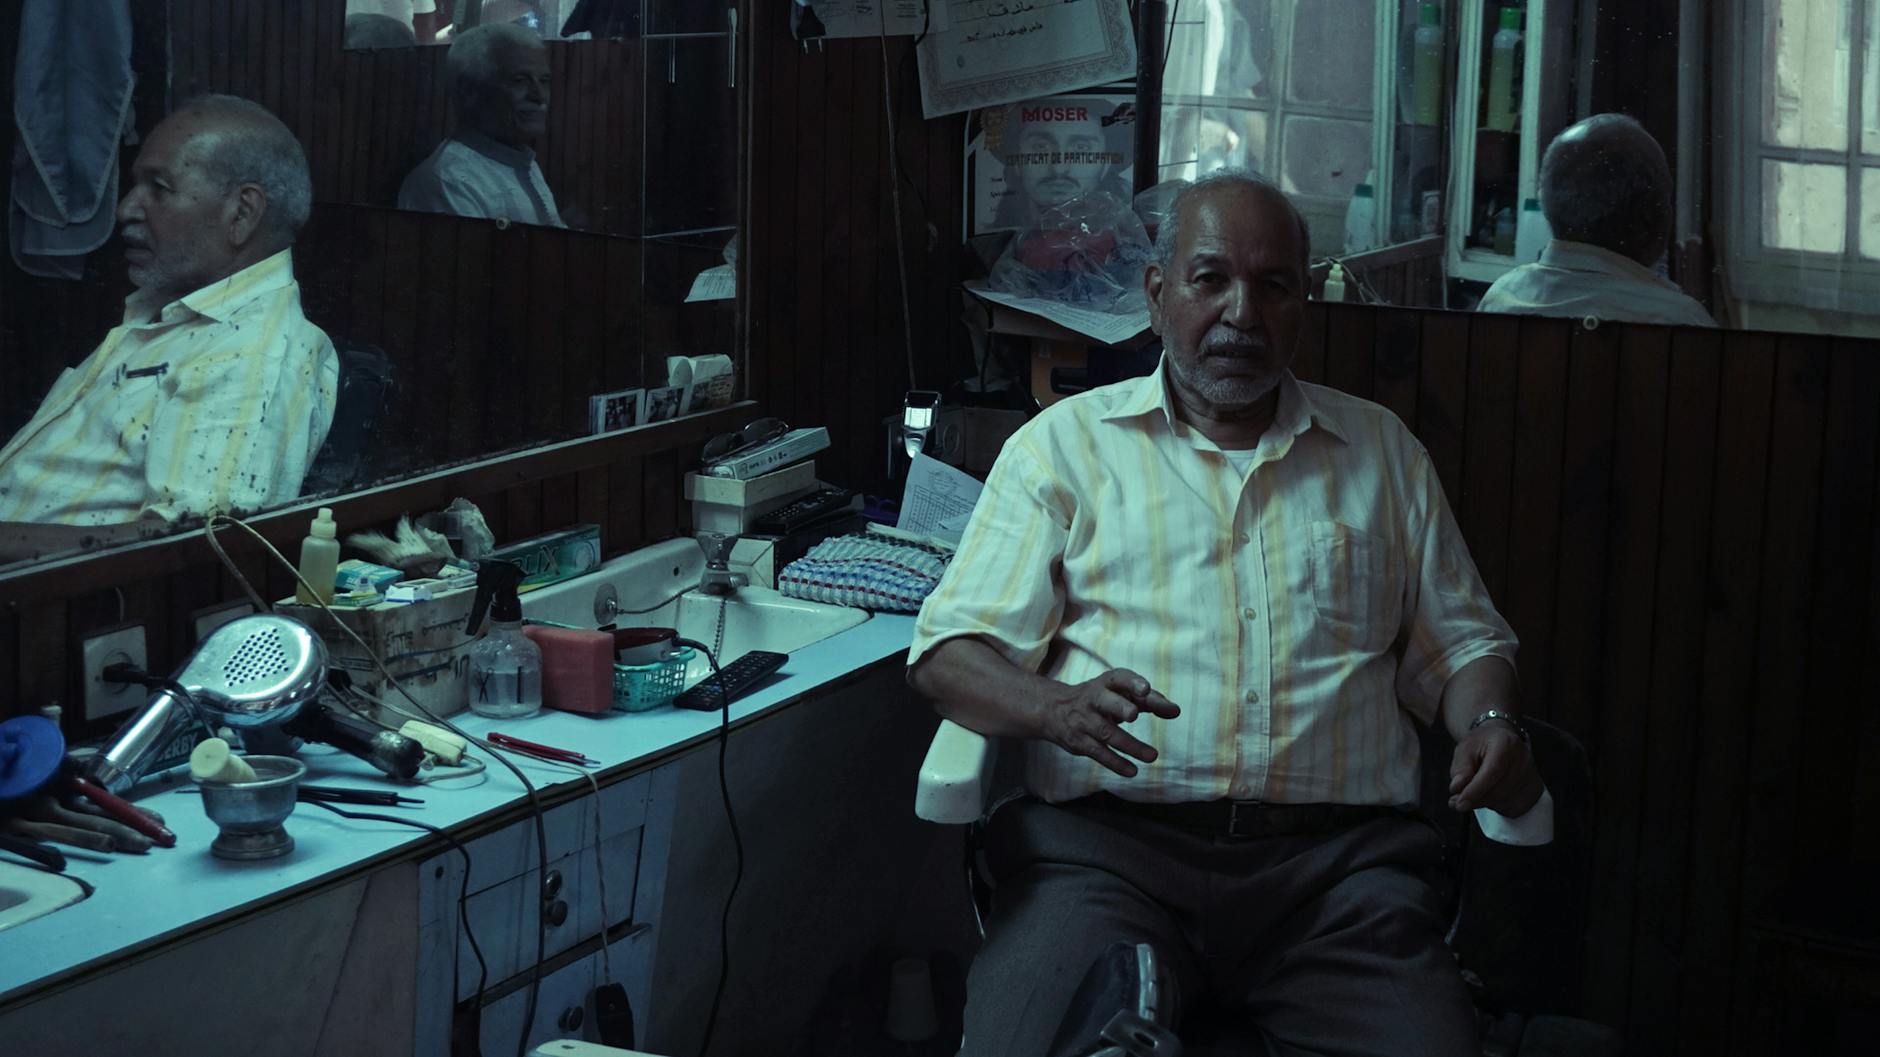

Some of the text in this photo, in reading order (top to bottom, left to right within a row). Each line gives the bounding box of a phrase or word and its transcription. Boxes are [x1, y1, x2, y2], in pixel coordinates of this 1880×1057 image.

[1023, 107, 1088, 121] MOSER
[1005, 153, 1048, 166] CERTIFICAT
[1051, 152, 1061, 165] DE
[157, 732, 198, 762] ERBY
